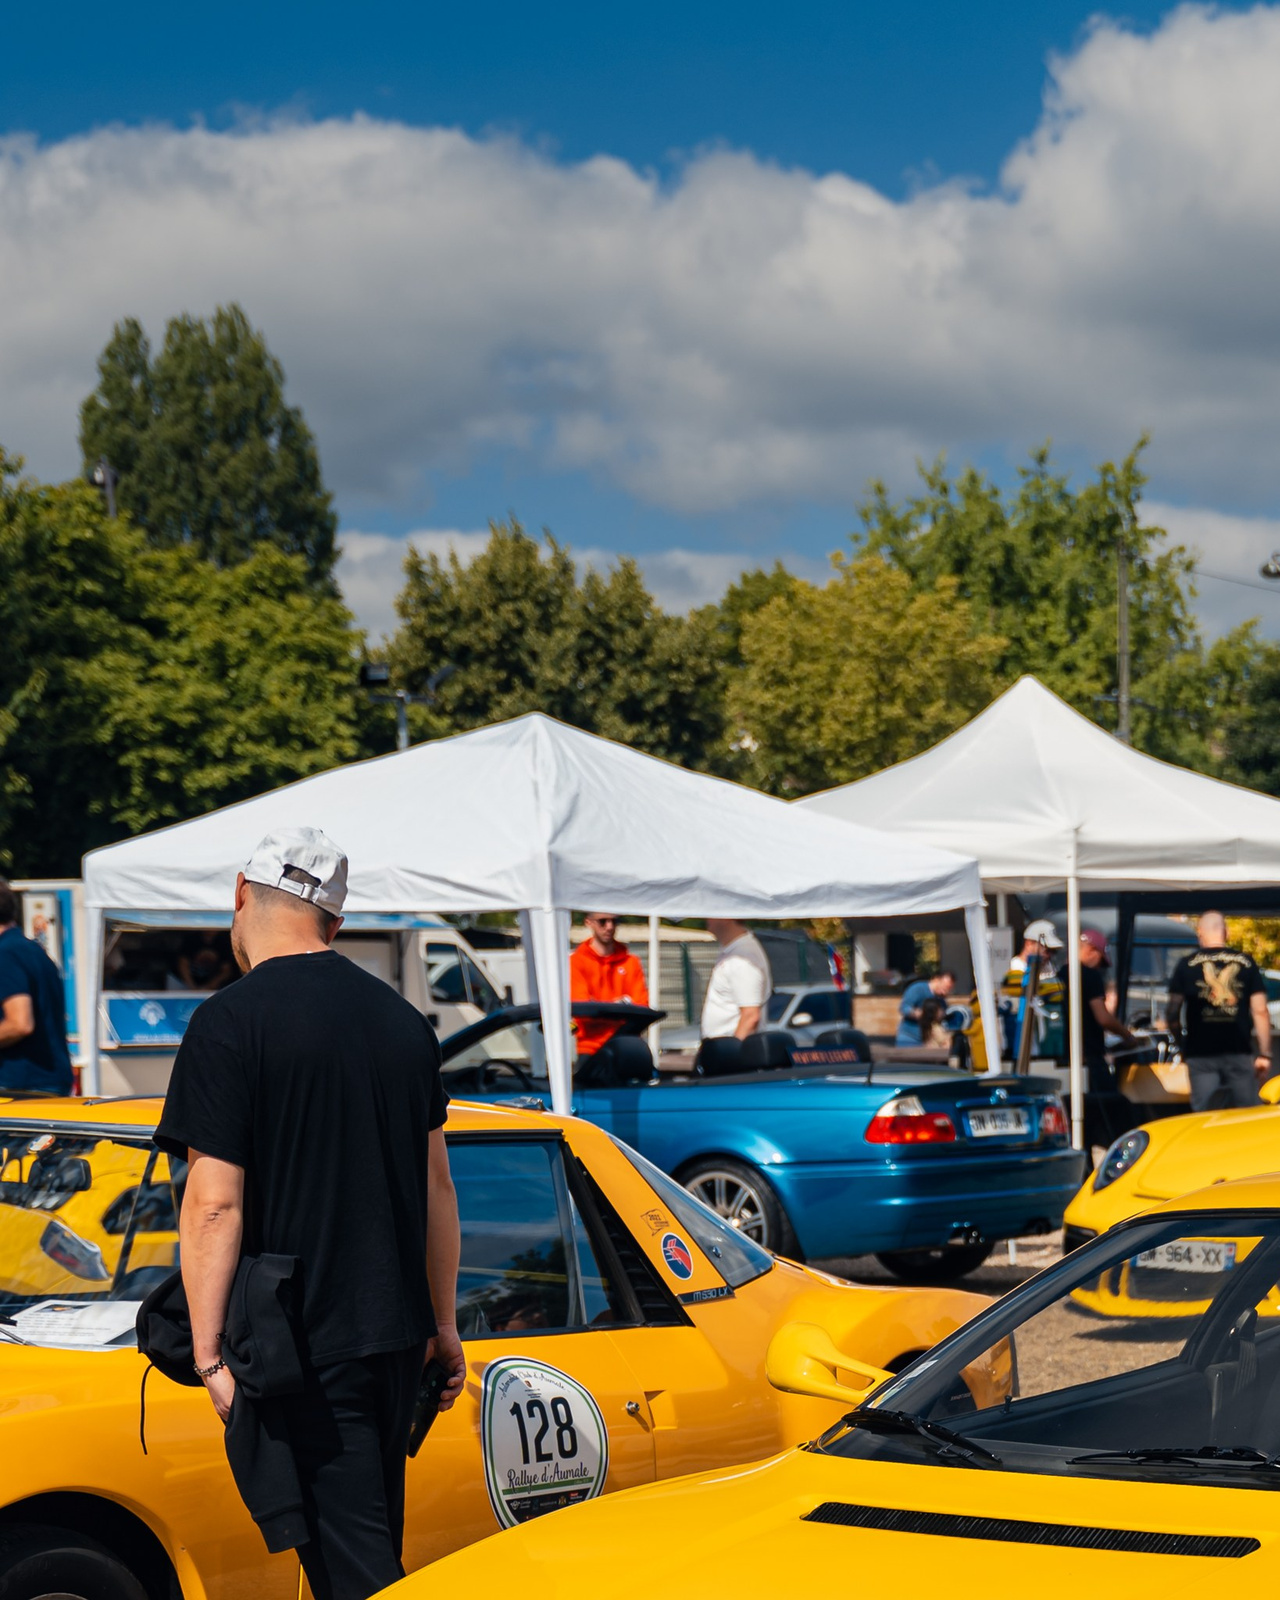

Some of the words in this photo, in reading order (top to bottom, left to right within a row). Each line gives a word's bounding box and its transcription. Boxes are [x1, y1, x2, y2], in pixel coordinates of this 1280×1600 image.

[509, 1396, 578, 1465] 128
[507, 1468, 540, 1494] Rallye
[541, 1462, 590, 1484] d'Aumale
